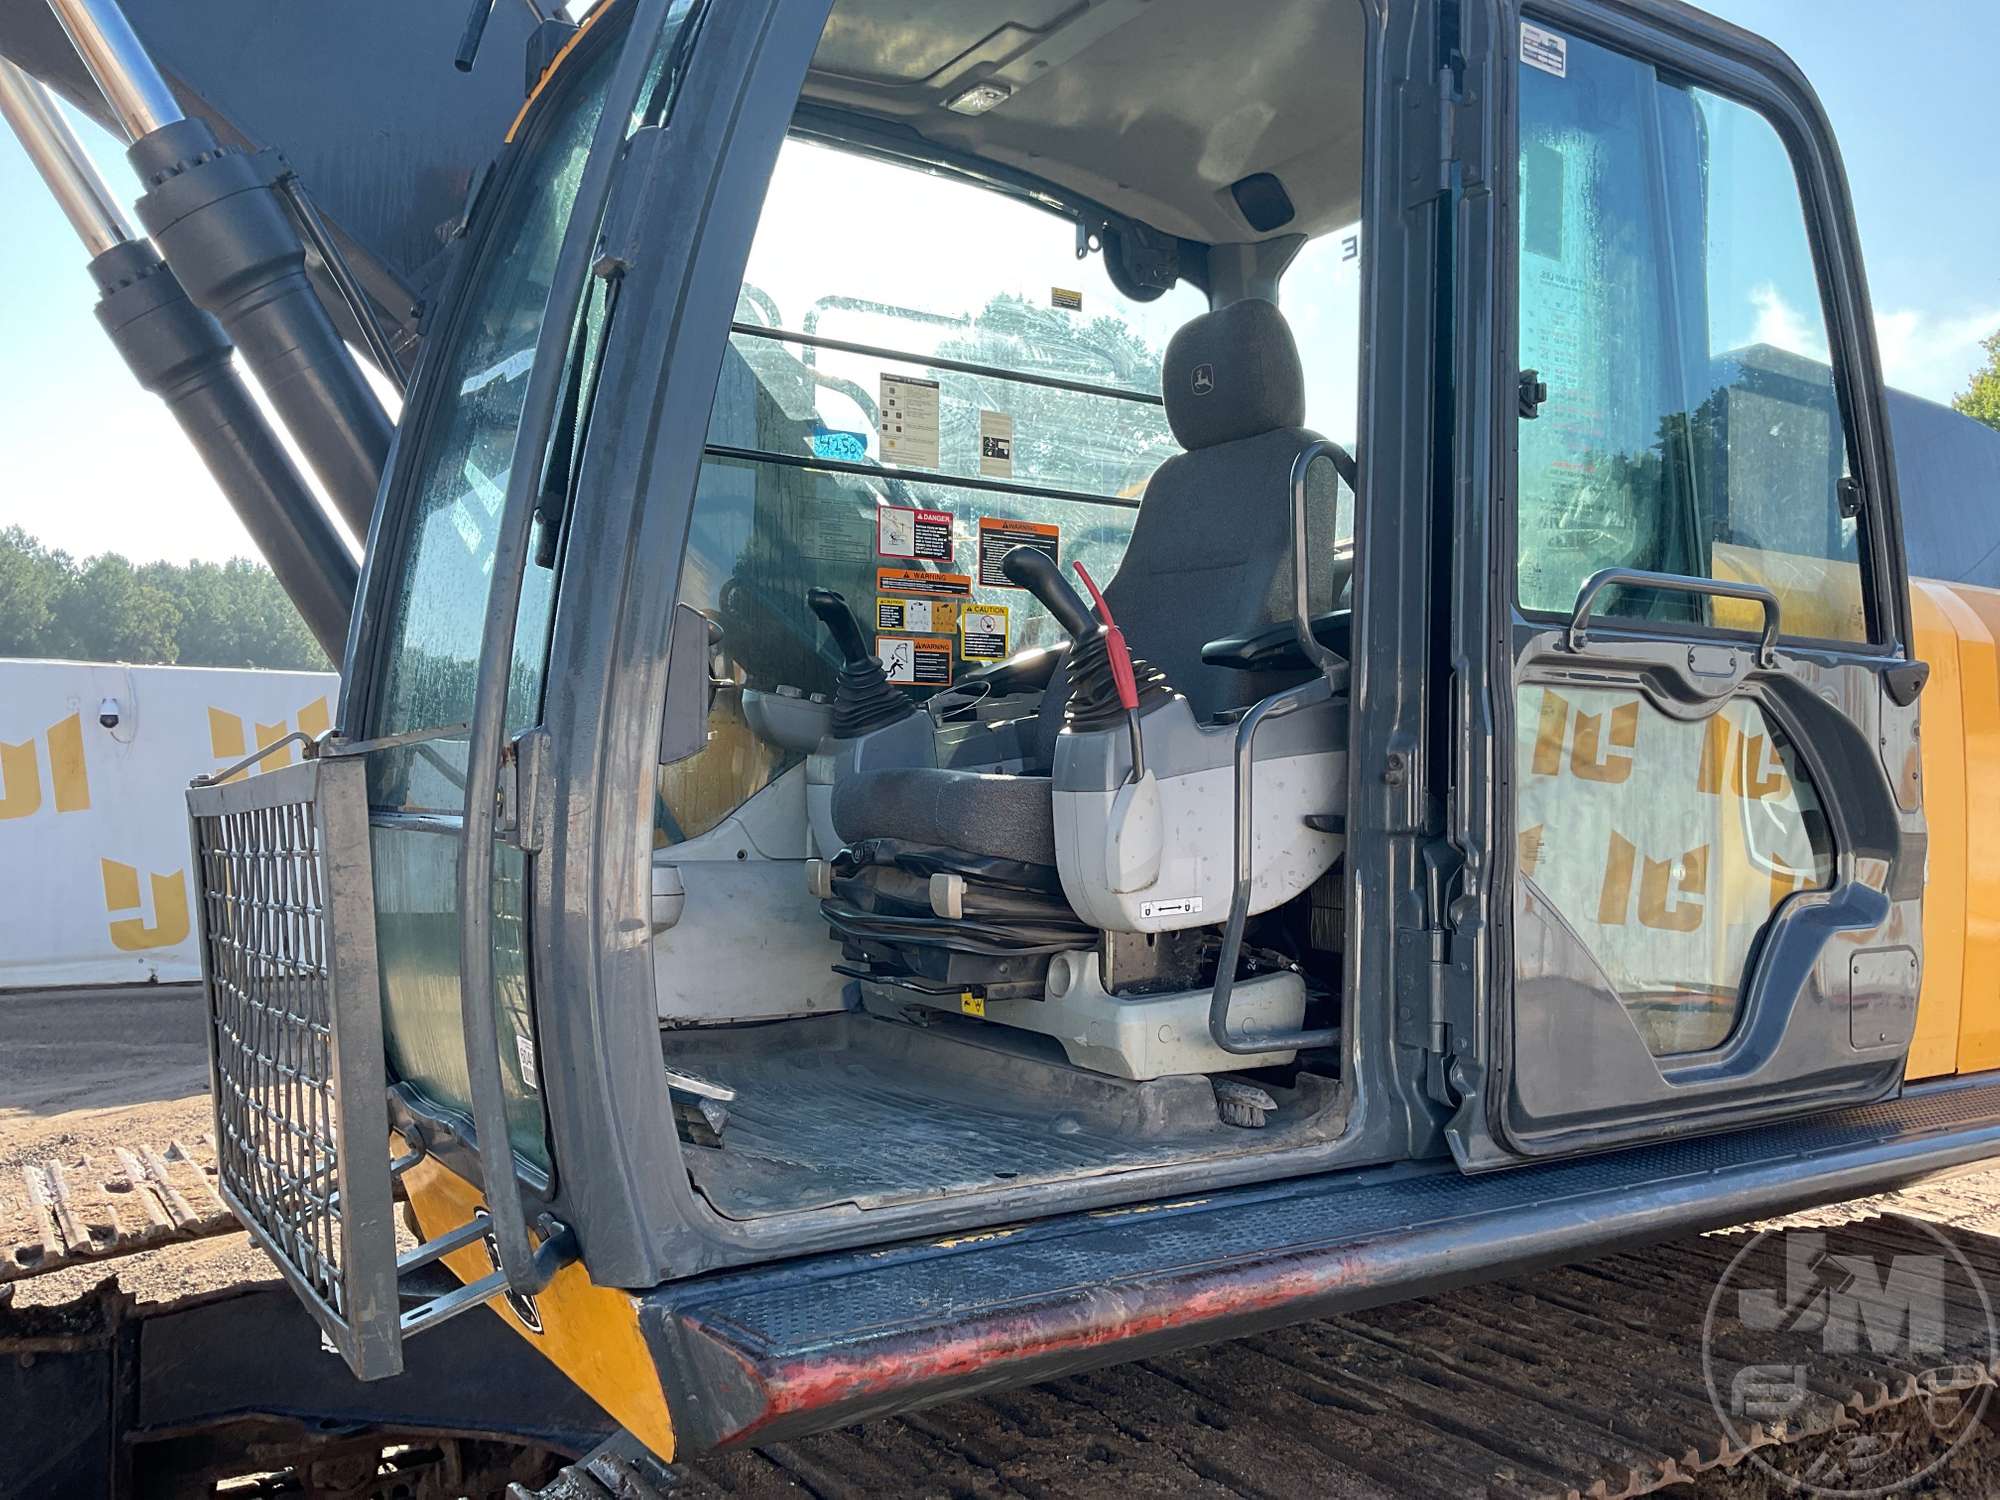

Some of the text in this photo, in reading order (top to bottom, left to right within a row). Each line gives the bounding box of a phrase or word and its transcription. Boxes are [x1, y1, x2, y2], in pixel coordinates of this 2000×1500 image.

[923, 513, 950, 522] DANGER
[1008, 522, 1038, 532] WARNING
[913, 572, 947, 581] WARNING
[974, 604, 1005, 614] CAUTION
[920, 641, 949, 650] WARNING
